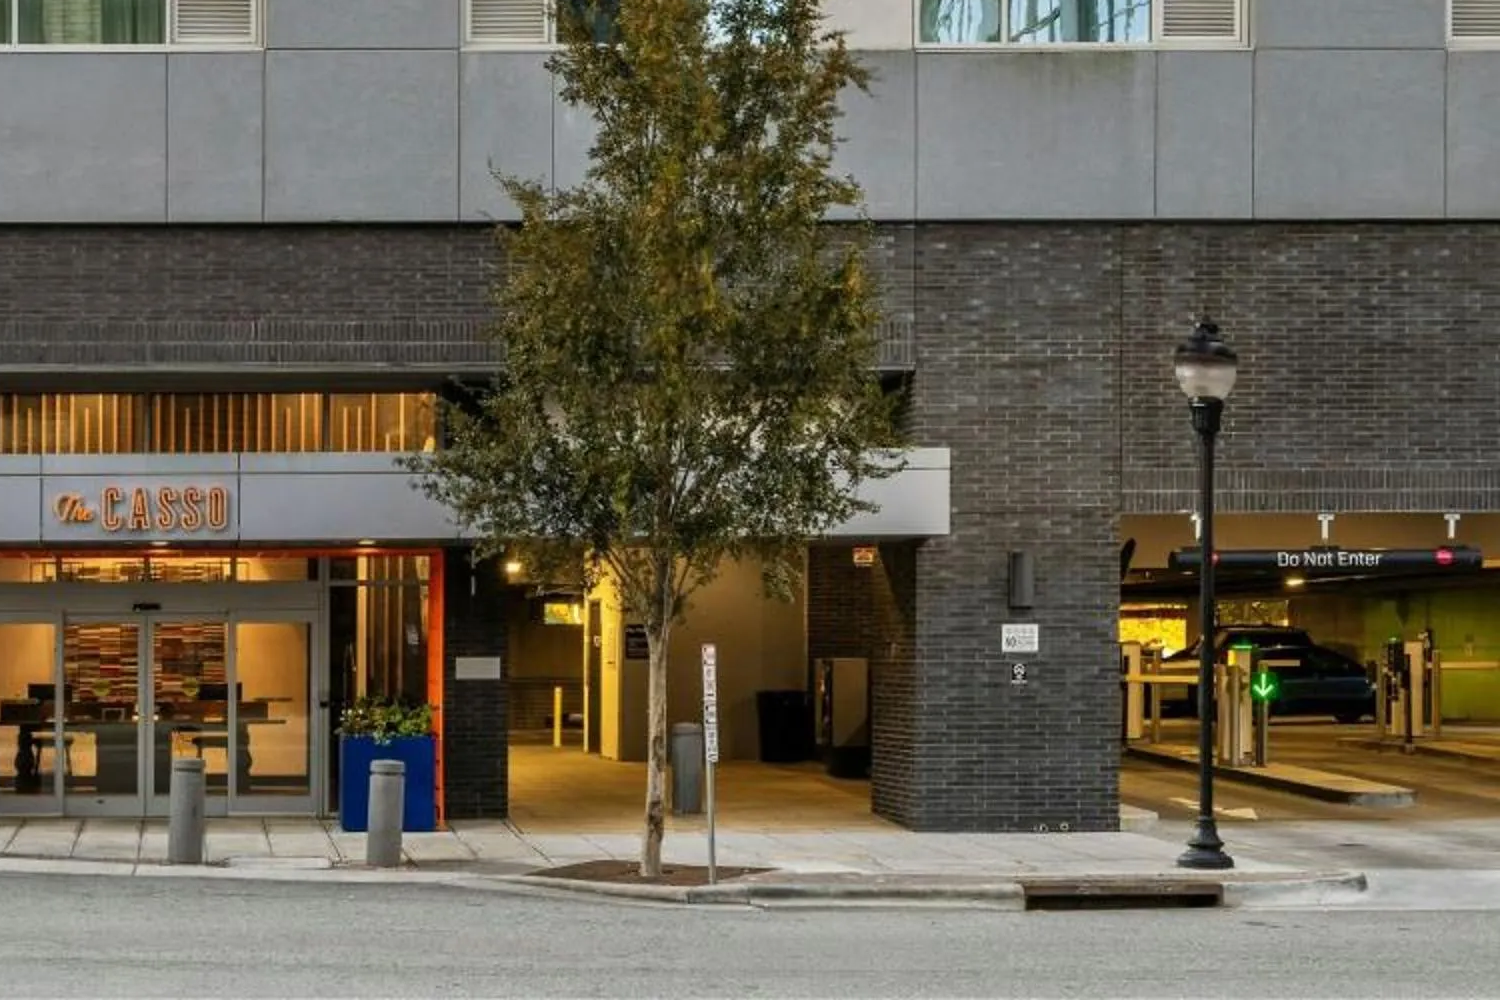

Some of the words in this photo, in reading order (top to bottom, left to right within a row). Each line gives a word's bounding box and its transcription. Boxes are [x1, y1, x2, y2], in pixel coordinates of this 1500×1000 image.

[53, 493, 94, 522] The
[100, 486, 228, 532] CASSO
[1277, 551, 1299, 567] Do
[1303, 551, 1333, 567] Not
[1338, 551, 1382, 567] Enter
